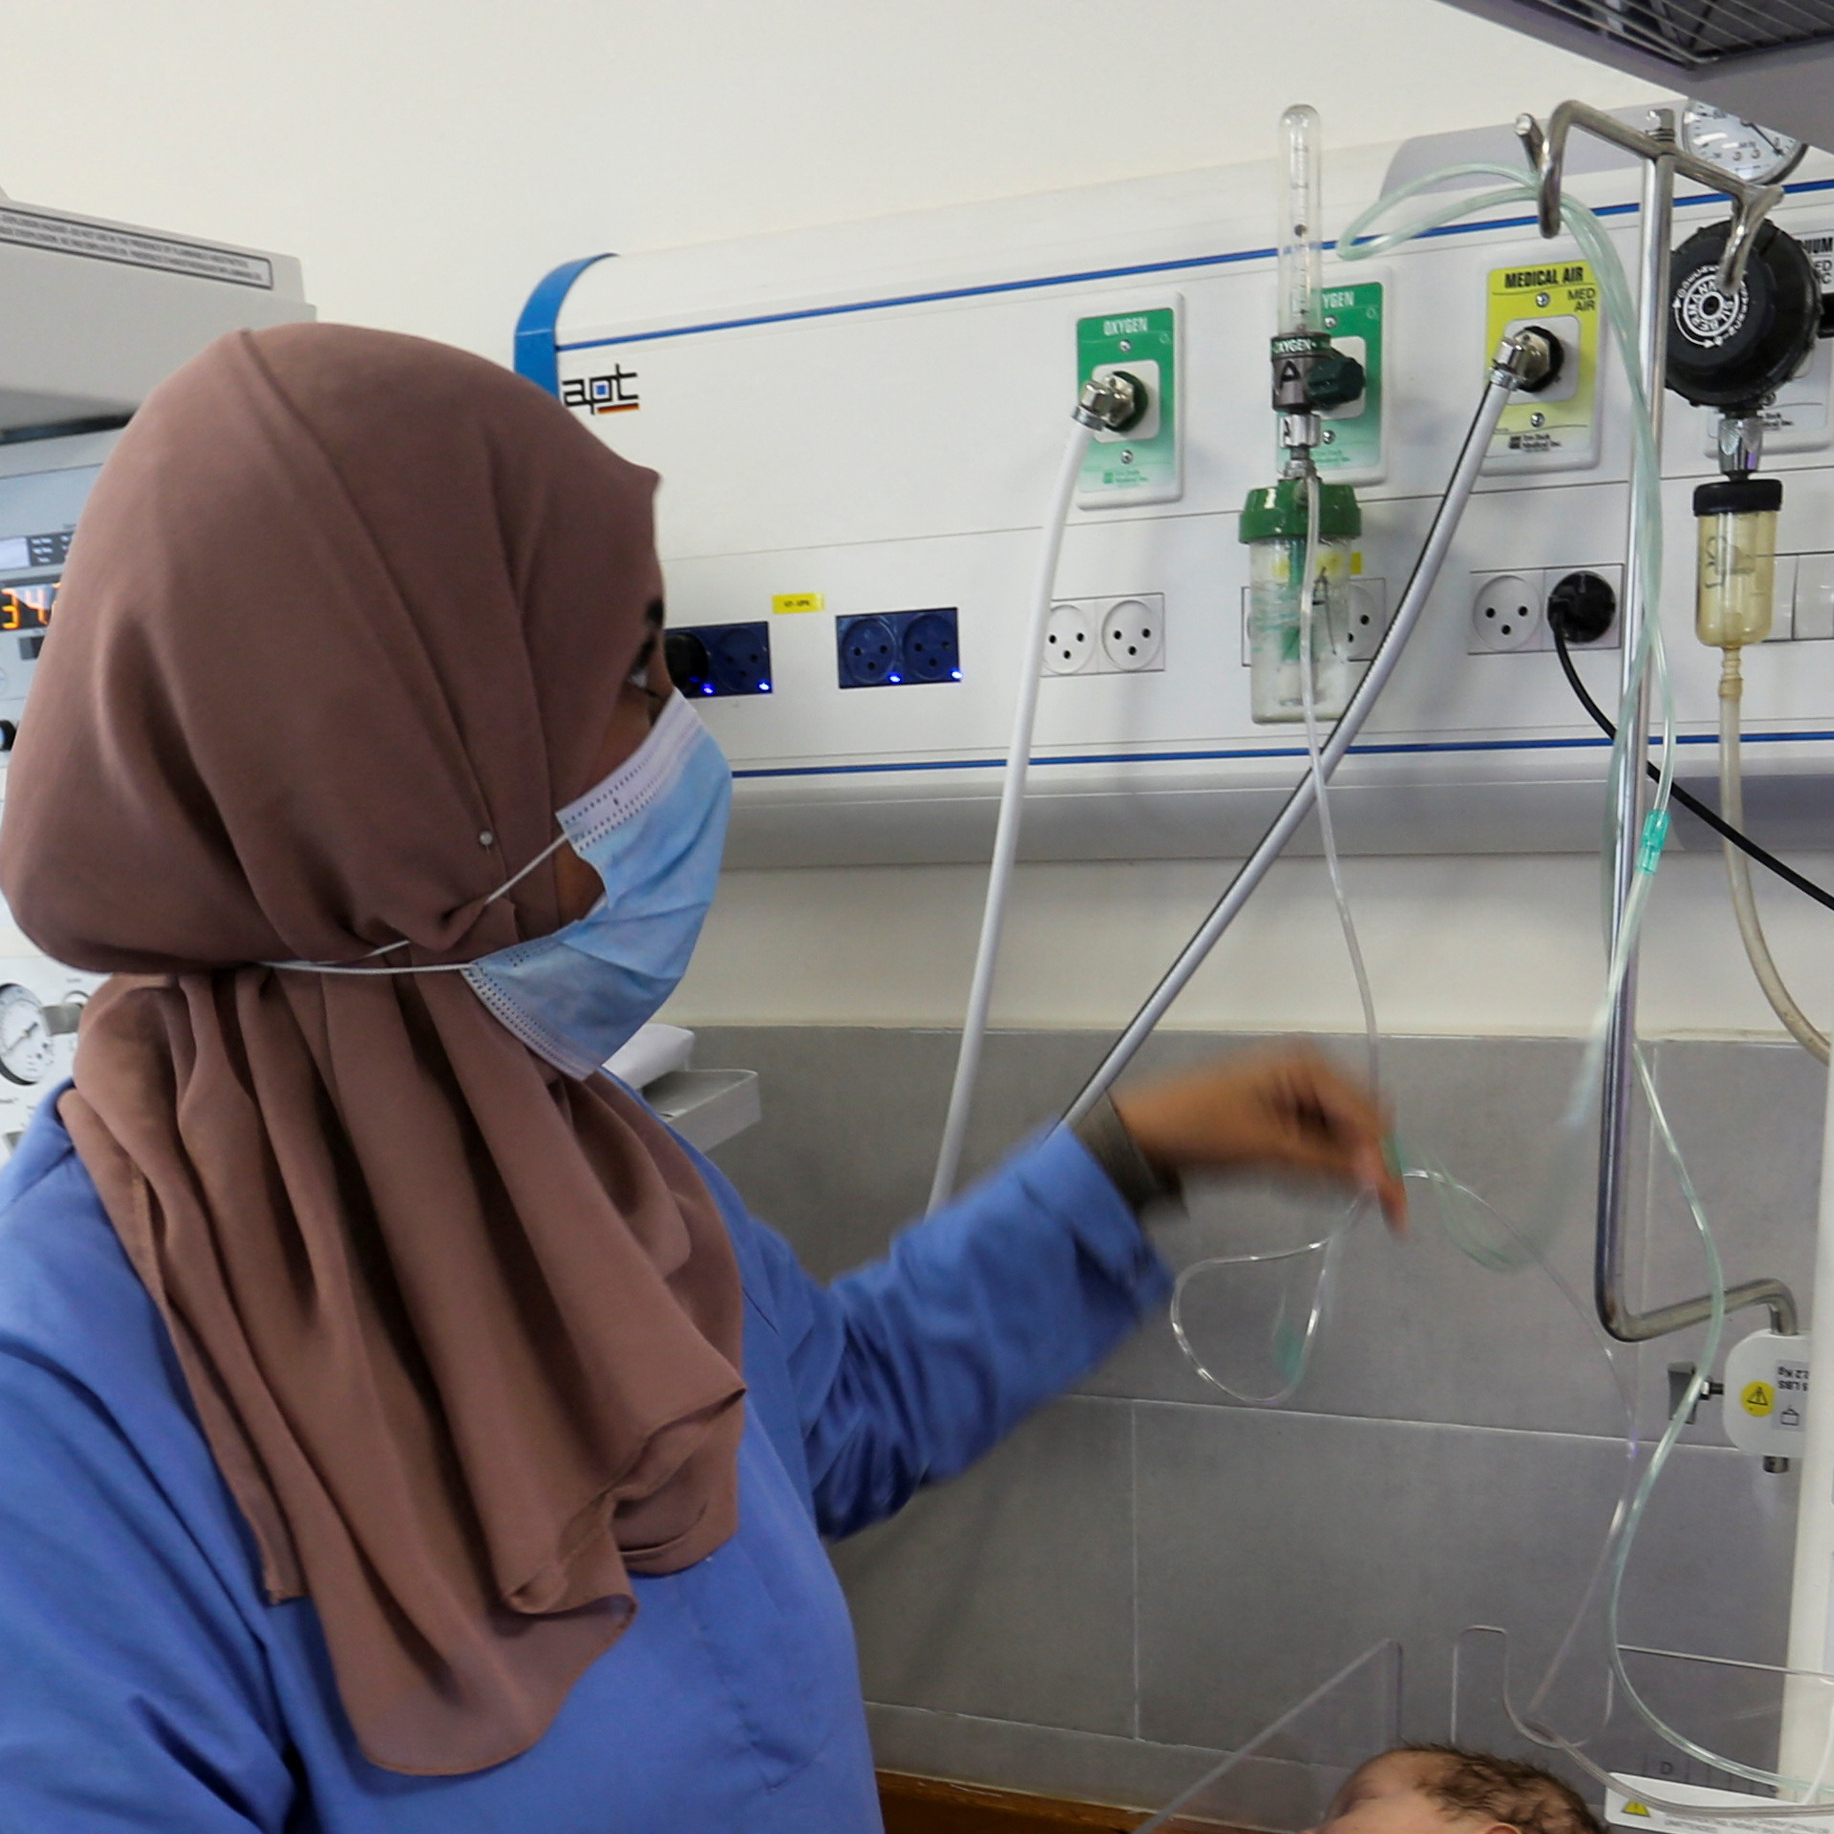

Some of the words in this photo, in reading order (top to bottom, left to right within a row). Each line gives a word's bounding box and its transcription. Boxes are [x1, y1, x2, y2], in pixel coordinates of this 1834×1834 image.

[1504, 269, 1559, 289] MEDICAL
[1562, 266, 1584, 283] AIR
[1321, 291, 1355, 309] YGEN
[1567, 288, 1596, 301] MED
[1575, 301, 1596, 313] AIR
[1103, 317, 1148, 336] OXYGEN
